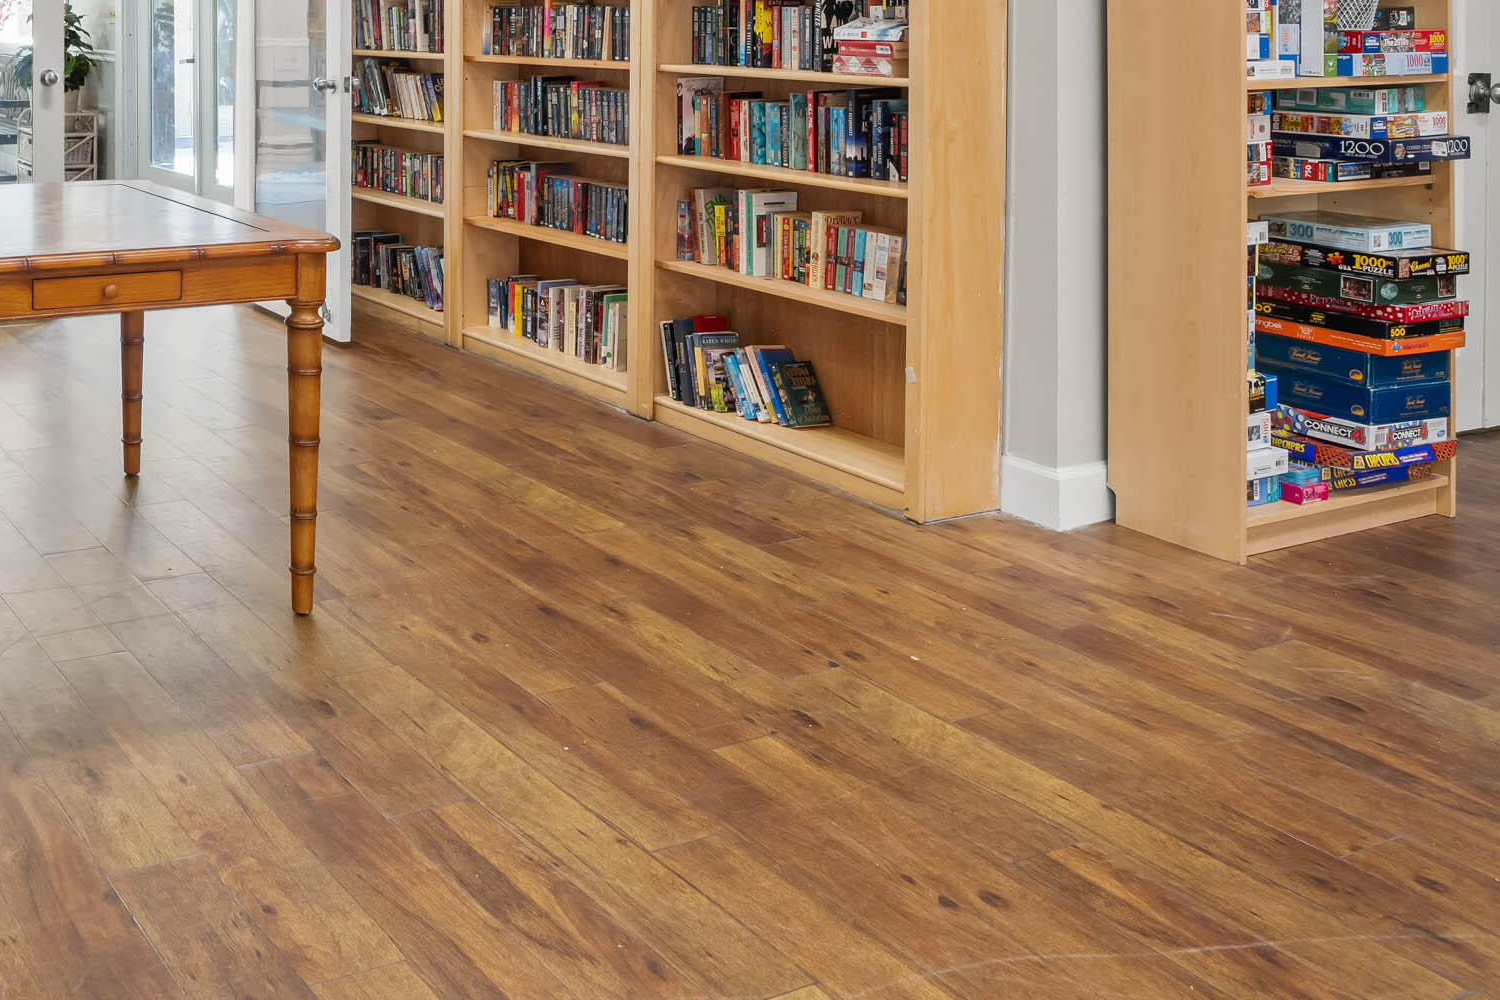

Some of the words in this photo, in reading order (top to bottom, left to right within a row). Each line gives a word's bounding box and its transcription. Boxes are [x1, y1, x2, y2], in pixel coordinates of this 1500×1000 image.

[814, 2, 822, 26] WHITES
[1429, 33, 1445, 45] 1000
[1406, 54, 1424, 68] 1000
[1339, 139, 1385, 156] 1200
[1445, 138, 1469, 154] 1200
[1304, 164, 1313, 178] 750
[1288, 223, 1314, 239] 300
[1387, 231, 1403, 246] 300
[1362, 265, 1394, 276] PUZZLE
[1451, 263, 1469, 271] PUZZLE
[1390, 328, 1406, 338] 500
[1304, 419, 1352, 438] CONNECT
[1350, 427, 1366, 444] 4
[1392, 428, 1421, 440] CONNECT
[1419, 421, 1429, 440] 4
[1365, 452, 1400, 469] CHECKERS
